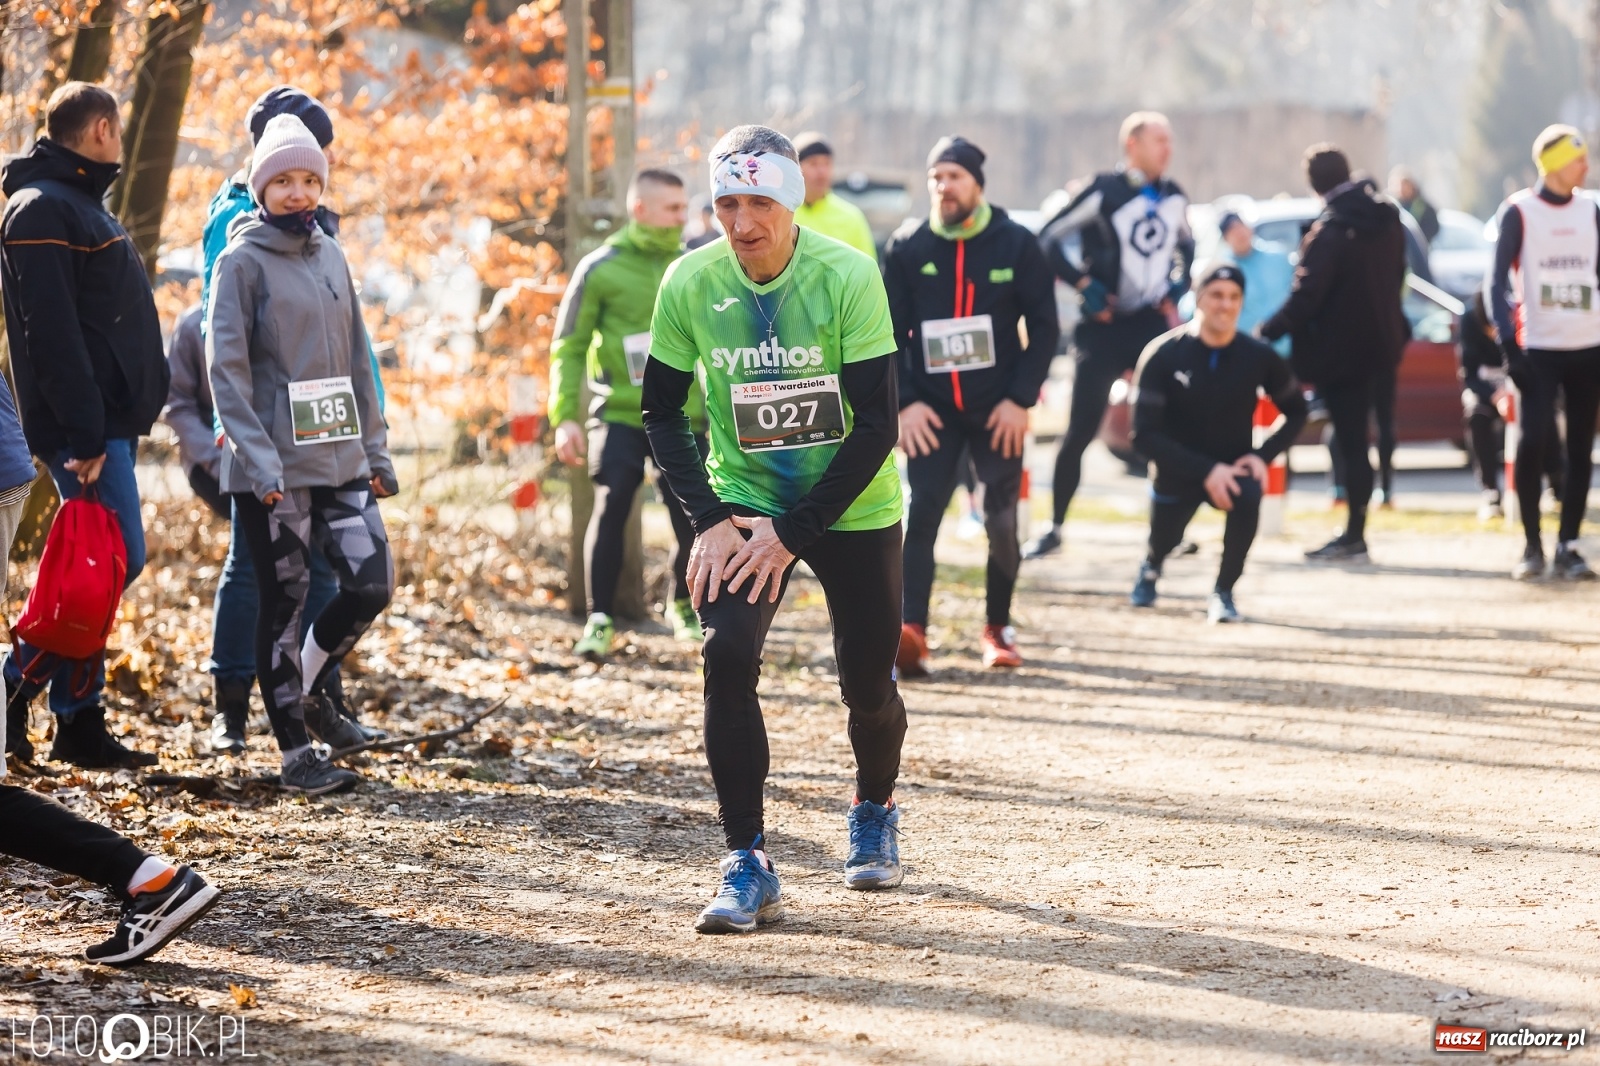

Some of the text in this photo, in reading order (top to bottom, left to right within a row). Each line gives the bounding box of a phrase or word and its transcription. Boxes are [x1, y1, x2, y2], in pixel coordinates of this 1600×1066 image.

[711, 336, 824, 376] synthos
[940, 333, 974, 357] 161
[744, 366, 825, 376] chemical innovations
[742, 379, 826, 394] X BIEG Twardziela
[310, 397, 347, 424] 135
[757, 400, 819, 430] 027
